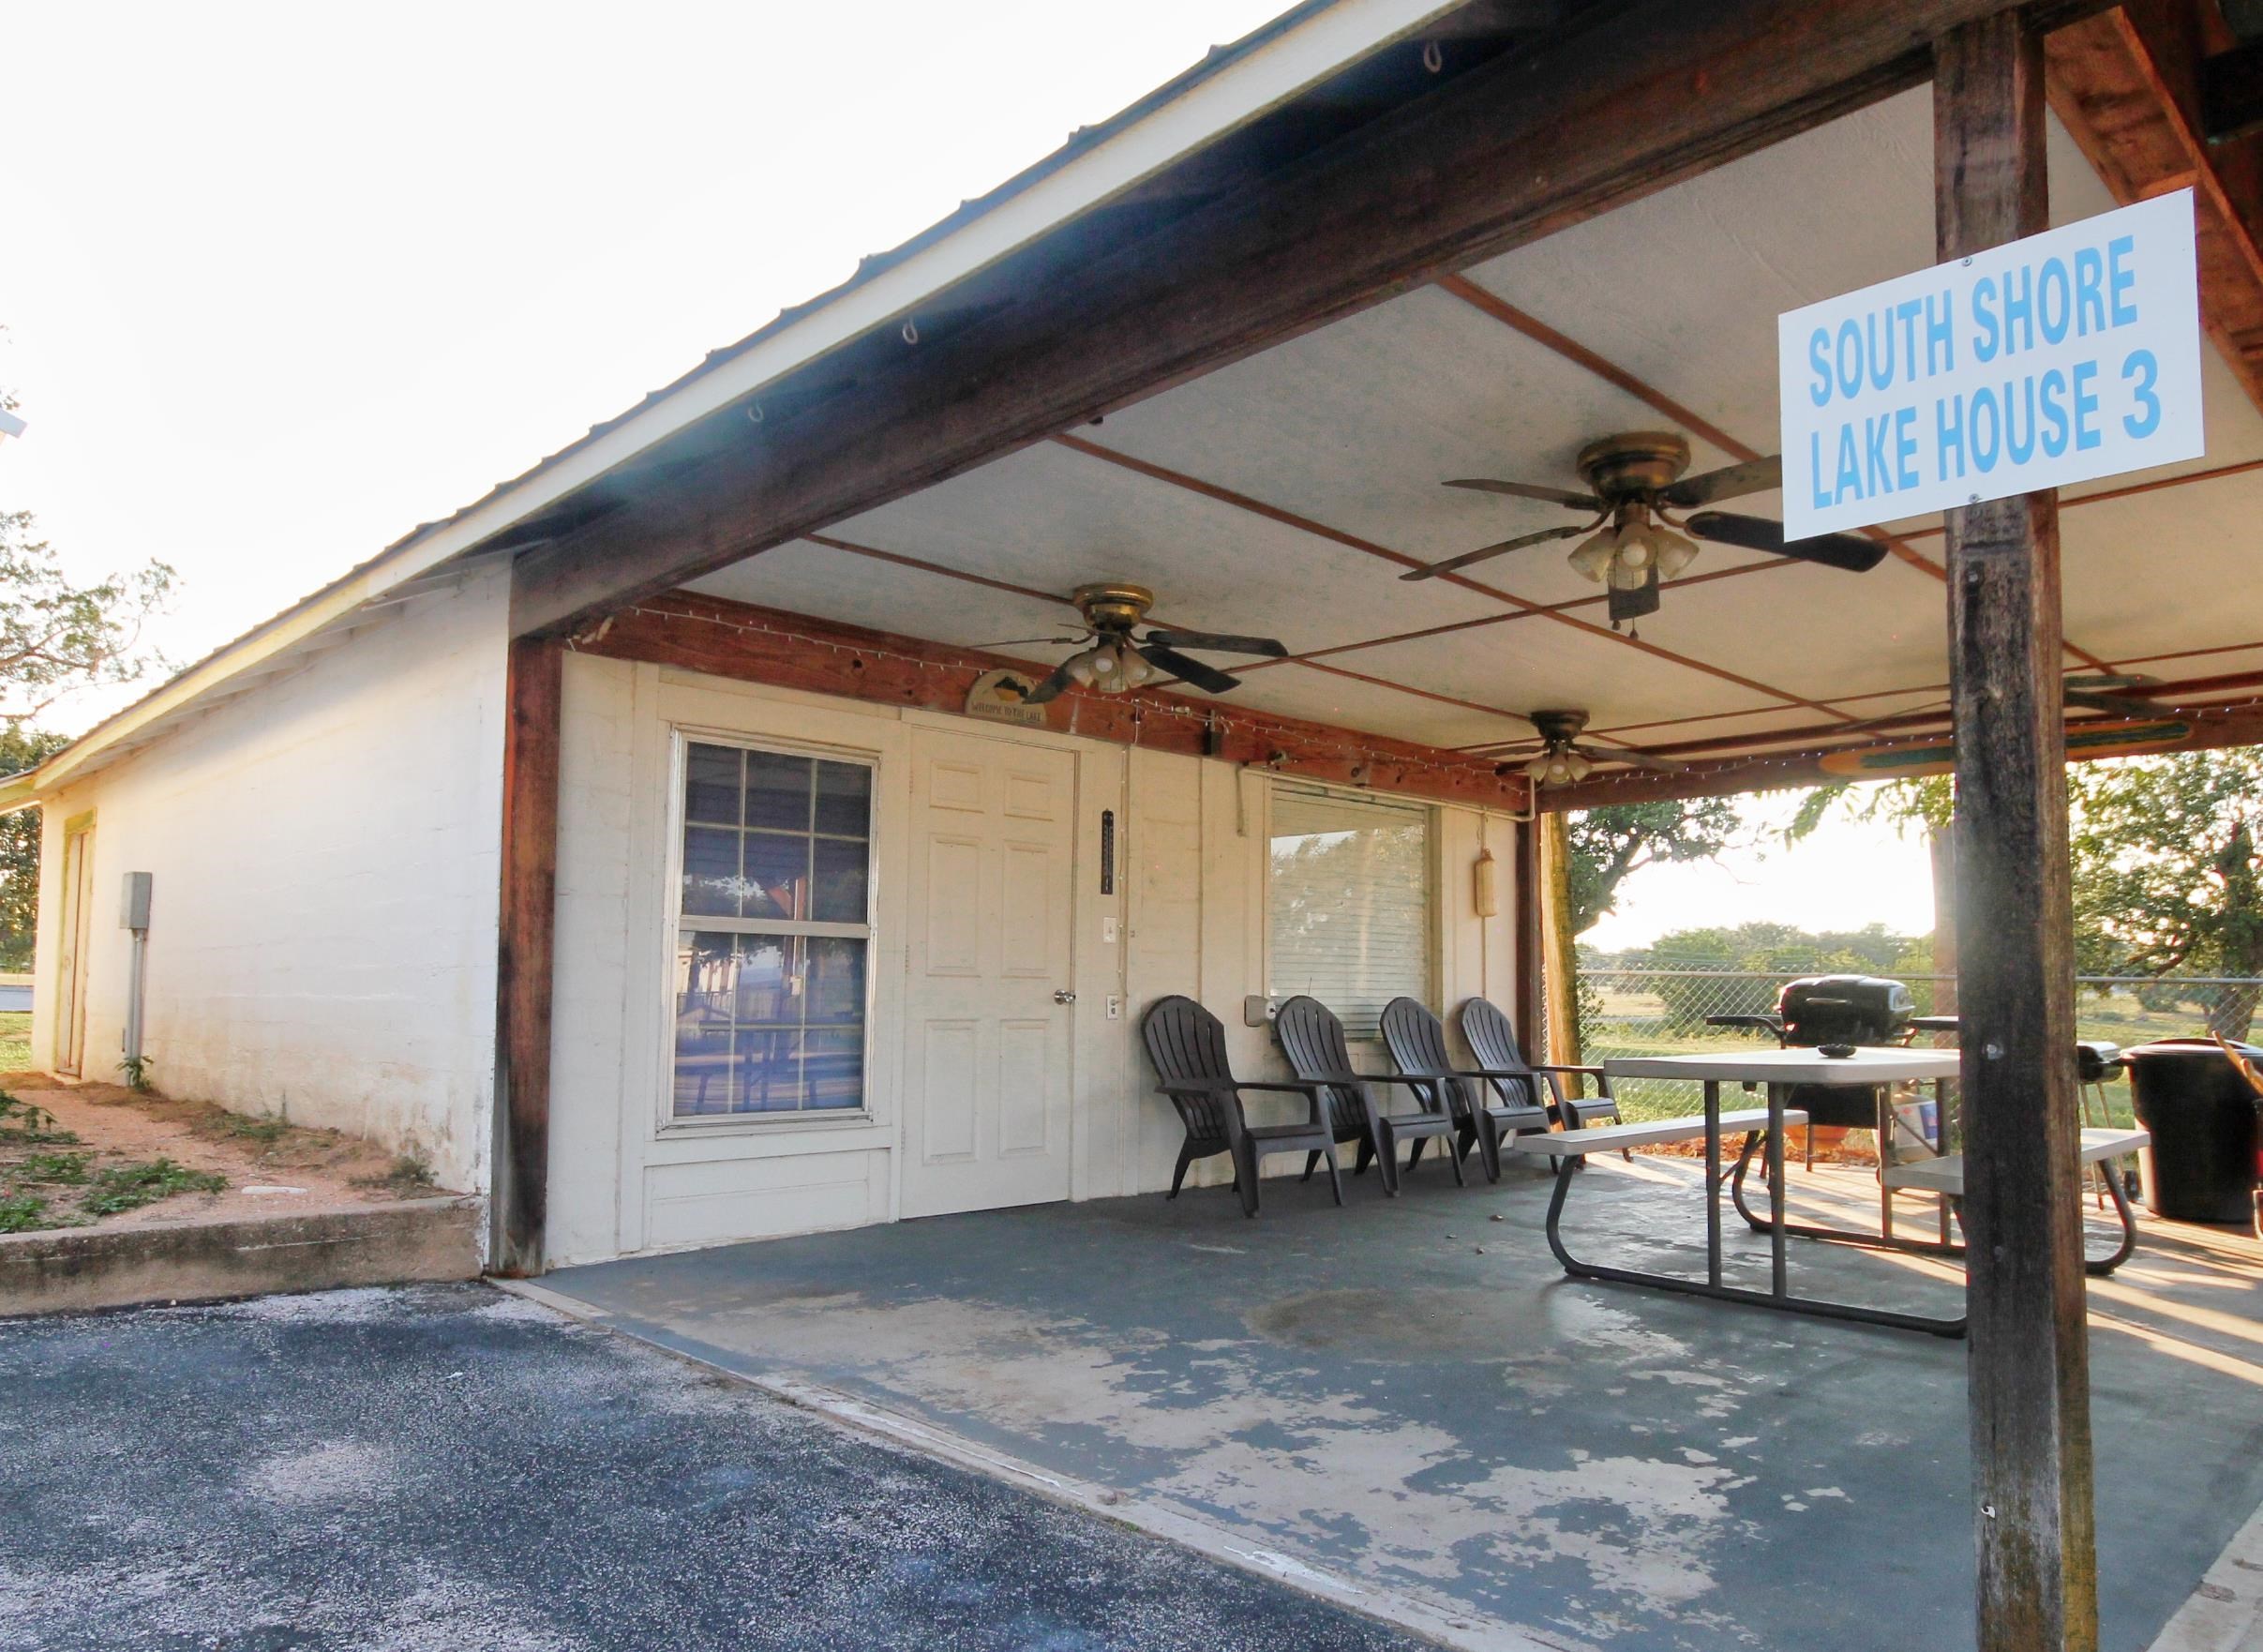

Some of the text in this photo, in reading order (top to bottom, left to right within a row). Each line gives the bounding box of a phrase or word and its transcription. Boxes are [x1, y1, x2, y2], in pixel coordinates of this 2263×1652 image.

[1809, 234, 2137, 407] SOUTH SHORE
[1811, 349, 2162, 510] LAKE HOUSE 3
[972, 702, 1002, 713] WELCOME
[1004, 706, 1012, 714] TO
[1026, 711, 1042, 721] LAKE
